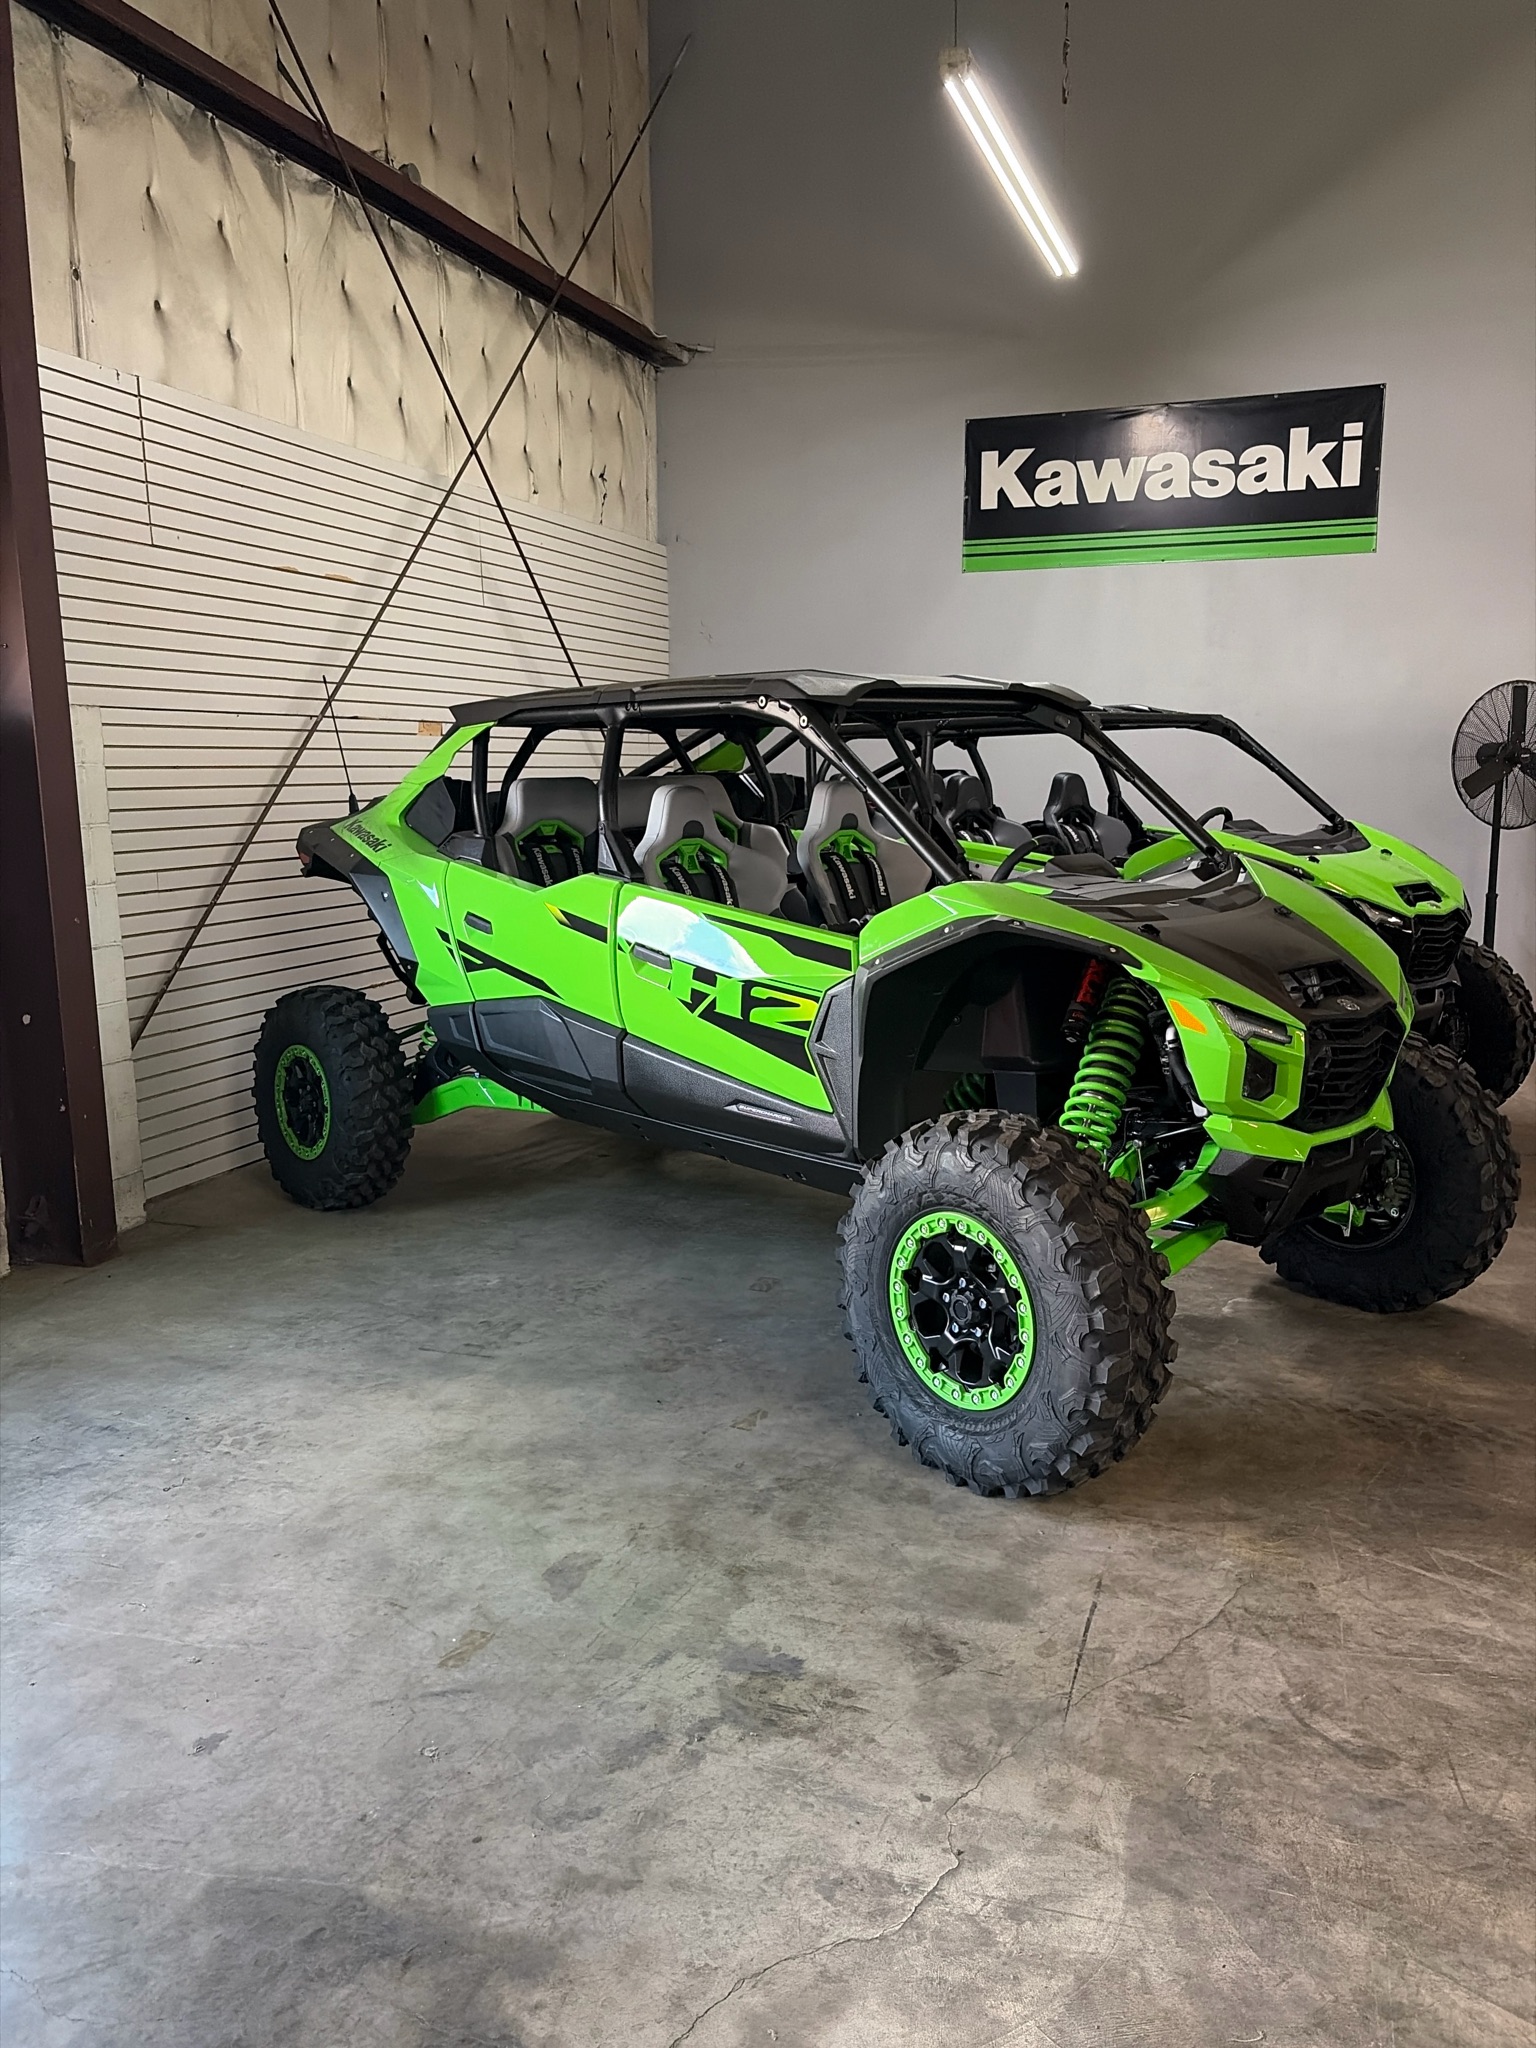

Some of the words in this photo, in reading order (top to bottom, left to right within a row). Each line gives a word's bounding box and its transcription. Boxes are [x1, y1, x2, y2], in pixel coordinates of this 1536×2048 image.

[980, 422, 1364, 510] Kawasaki
[344, 819, 392, 853] Kawasaki
[532, 847, 553, 887] Kawasak
[669, 866, 693, 897] Kawas
[710, 863, 733, 907] Kawasak
[830, 855, 856, 900] Kawasaki
[668, 958, 819, 1038] H2
